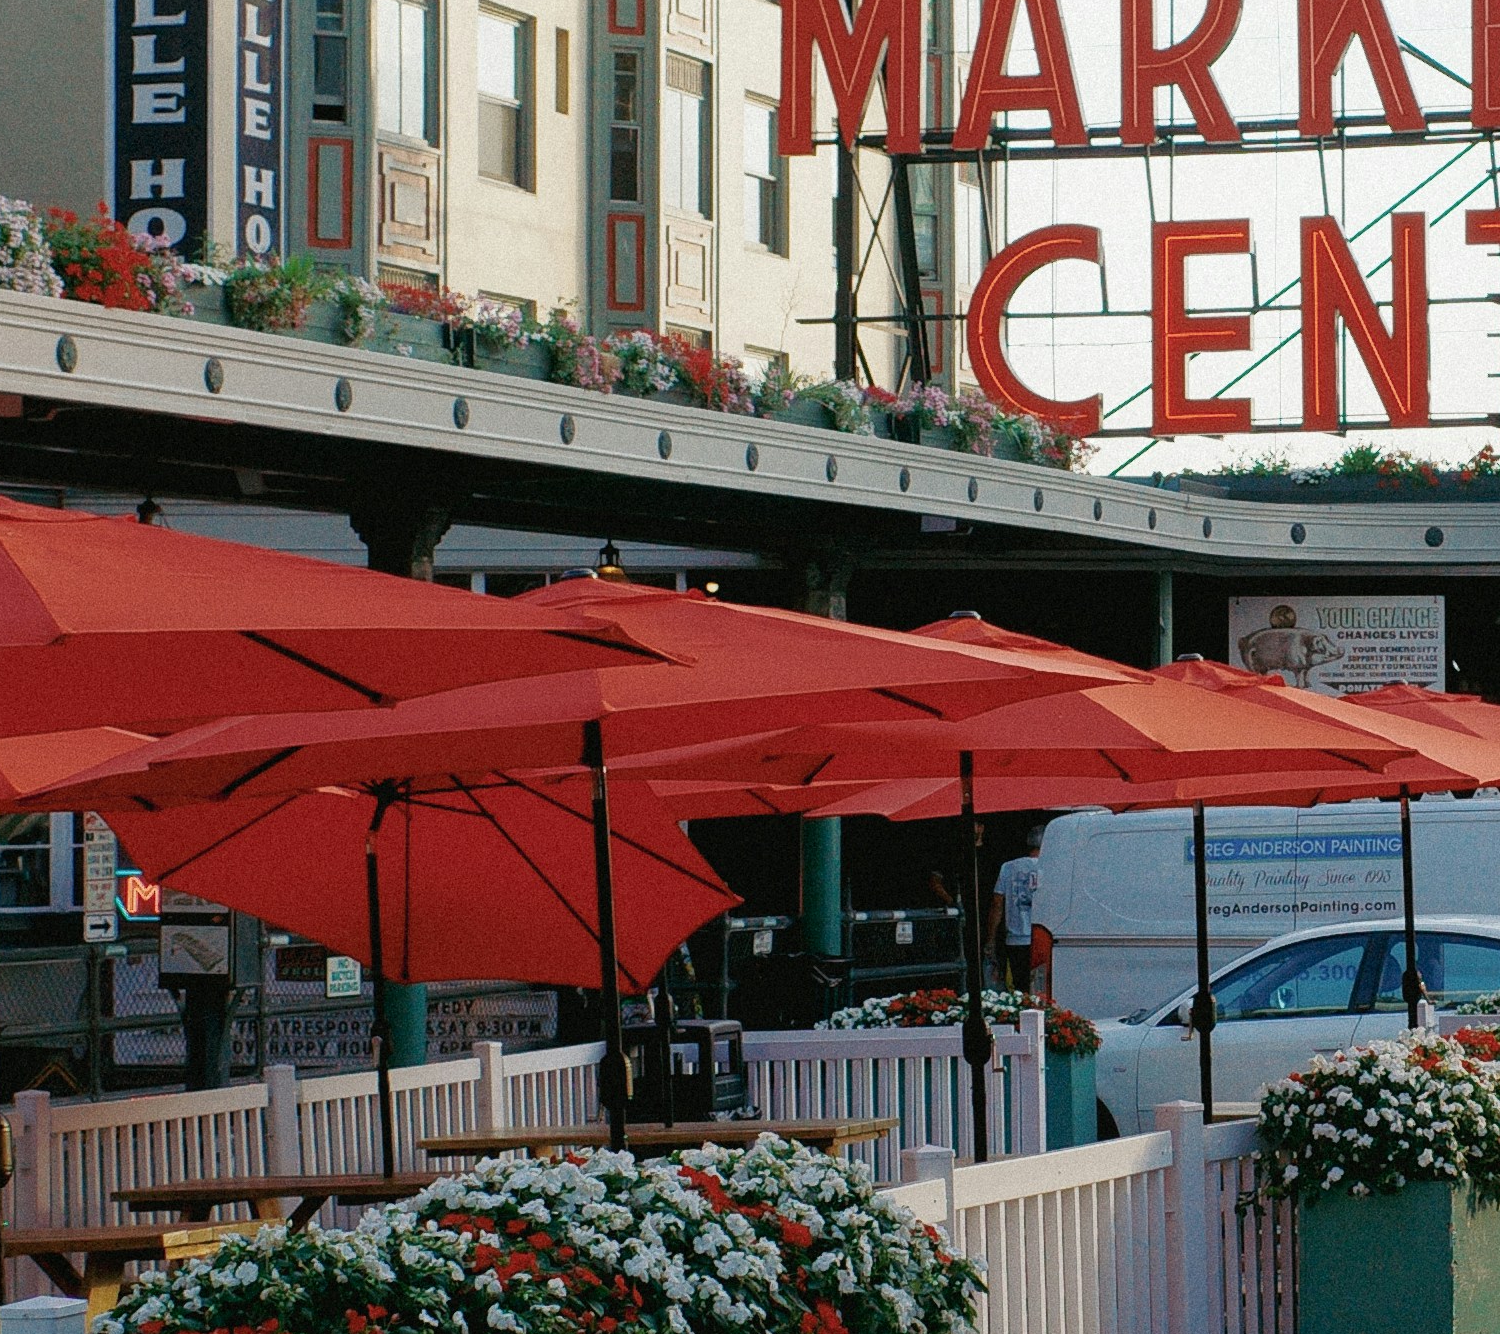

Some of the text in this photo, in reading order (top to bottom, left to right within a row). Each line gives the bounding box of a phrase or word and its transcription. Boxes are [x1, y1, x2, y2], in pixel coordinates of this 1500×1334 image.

[1316, 607, 1439, 628] YOUR CHANGE
[1337, 631, 1396, 639] CHANGES
[1239, 839, 1326, 856] ANDERSON
[1331, 837, 1402, 854] PAINTING
[1203, 868, 1246, 892] uality
[1253, 868, 1310, 890] Painting
[1318, 868, 1357, 888] Since
[1206, 900, 1396, 917] regAndersonPainting.com
[269, 1041, 328, 1055] HAPPY
[337, 1040, 372, 1055] HOU
